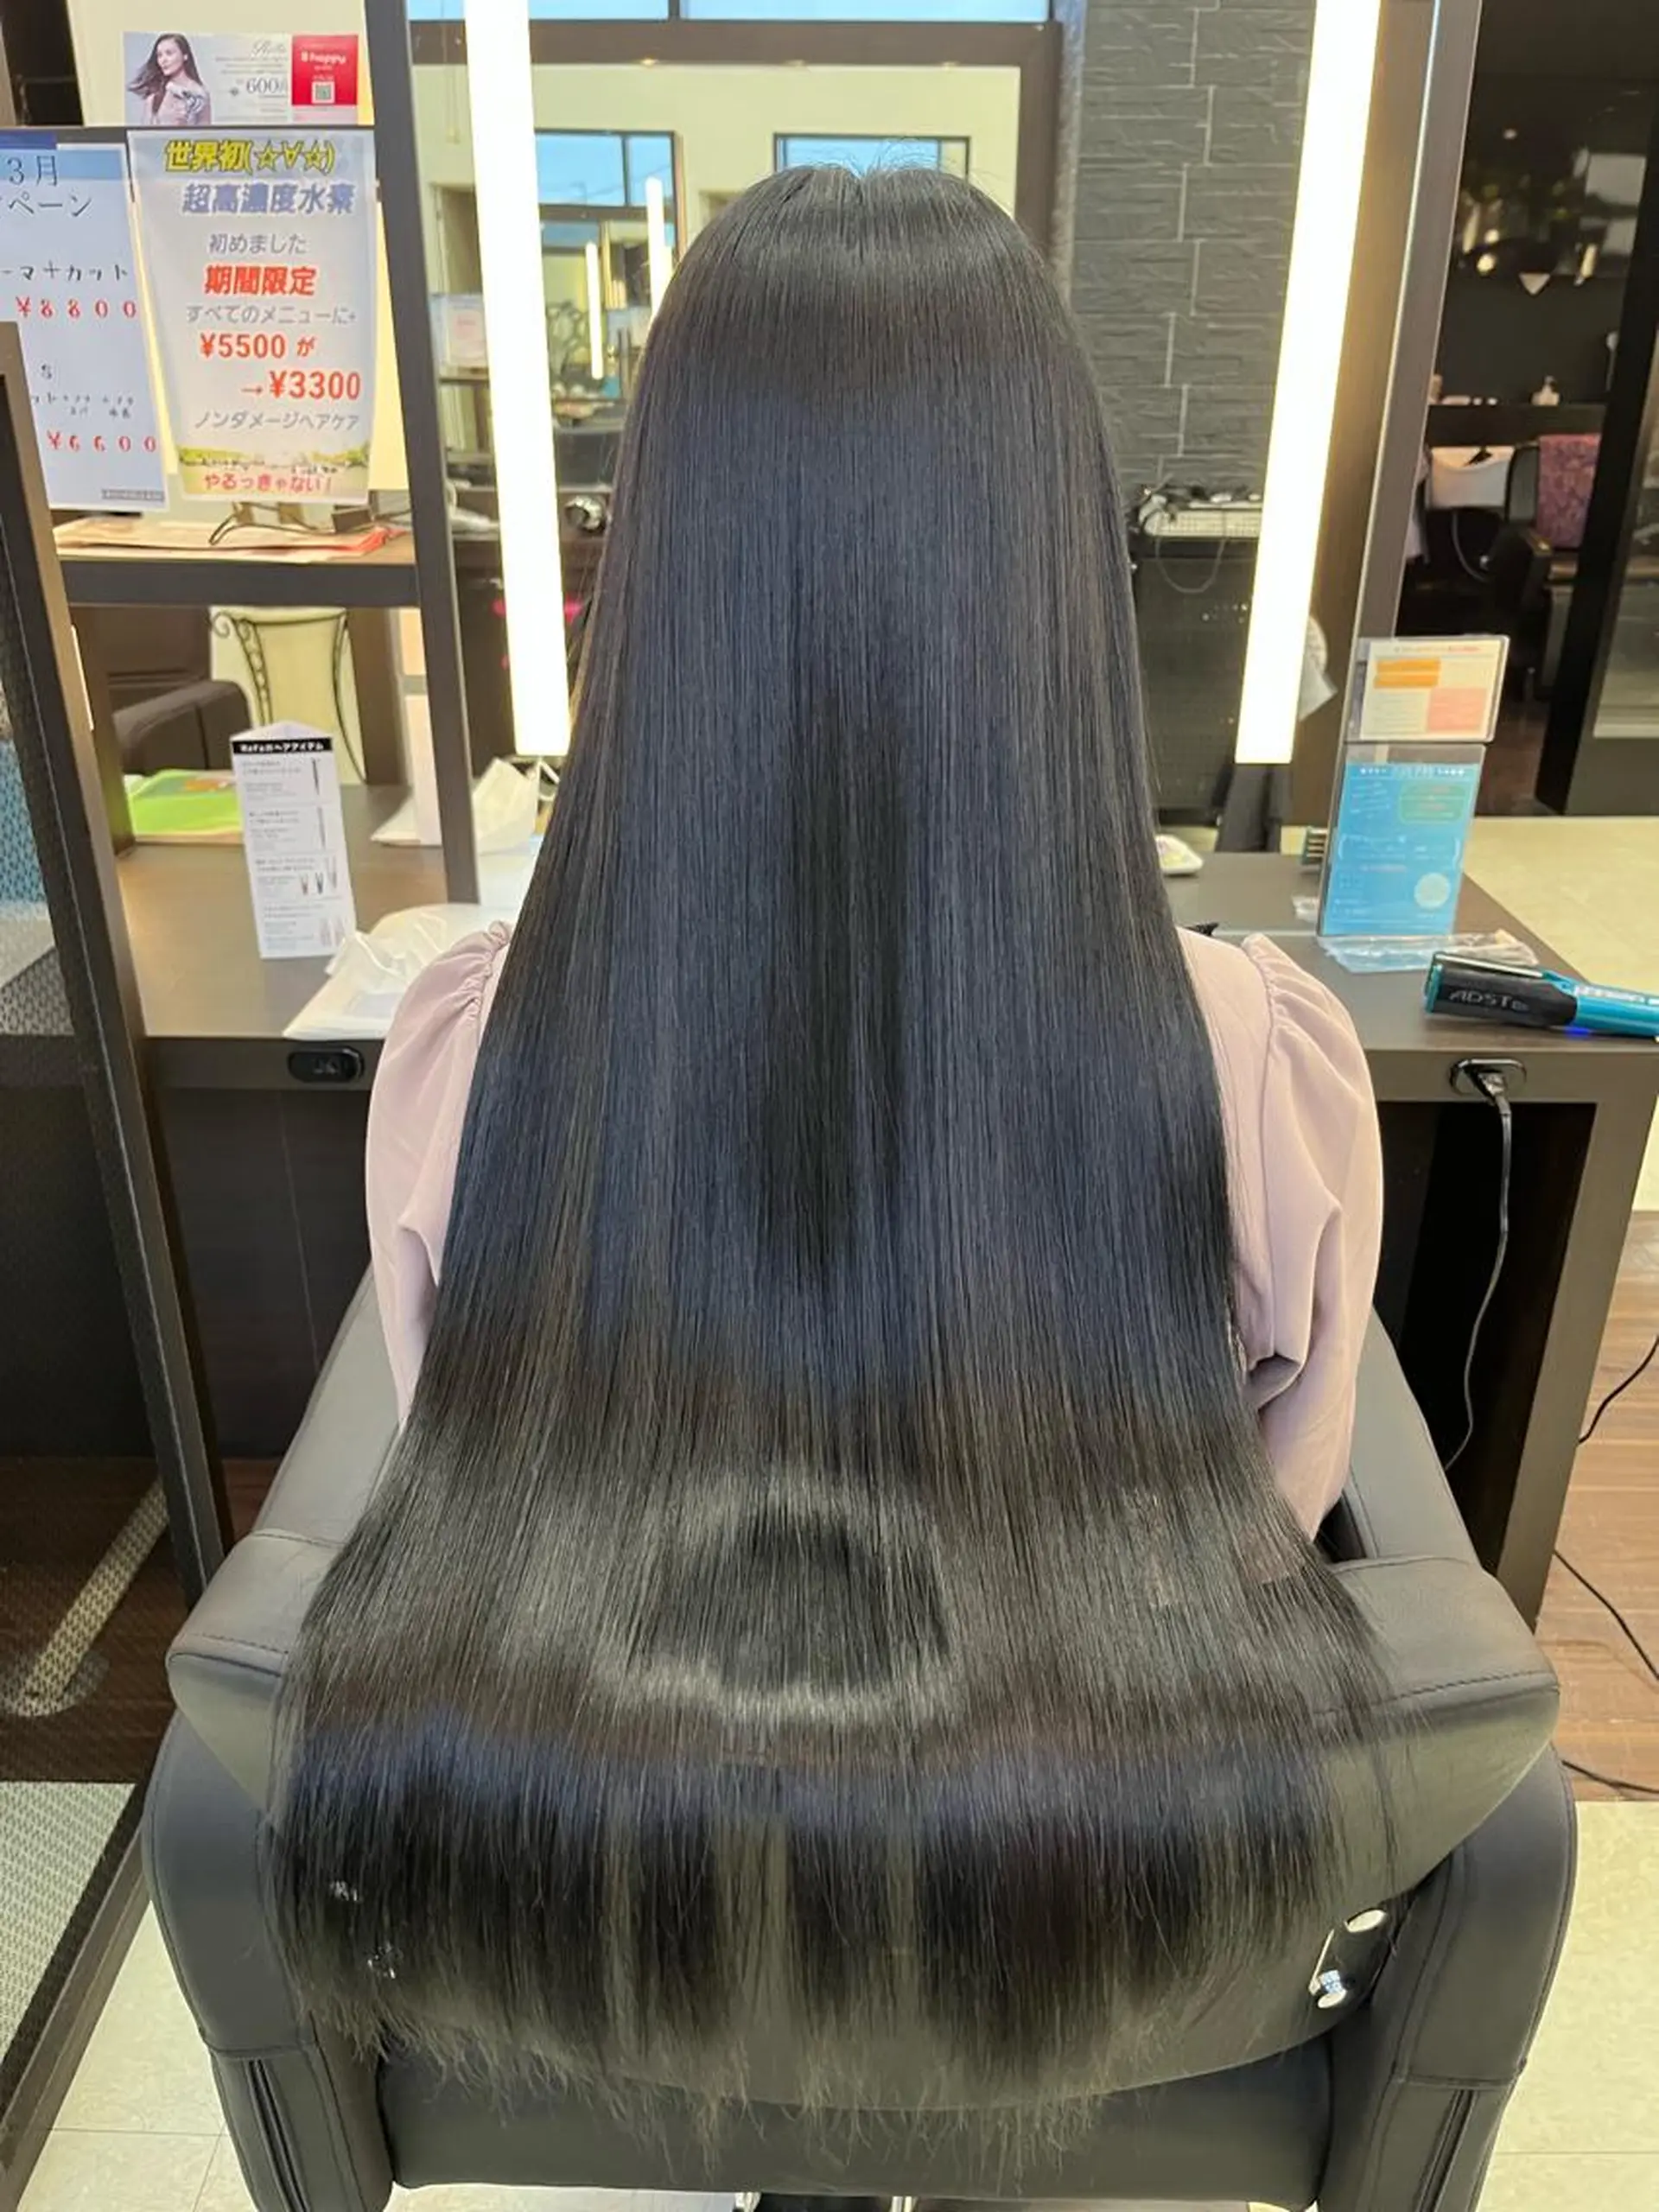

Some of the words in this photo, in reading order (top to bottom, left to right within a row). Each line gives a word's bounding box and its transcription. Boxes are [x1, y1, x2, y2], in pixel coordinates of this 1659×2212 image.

[182, 182, 355, 214] 超高濃度水素
[208, 232, 307, 255] 初めました
[204, 264, 317, 296] 期間限定
[200, 332, 286, 359] ¥5500
[296, 335, 316, 358] が
[195, 409, 359, 430] ノンダメージヘアケア
